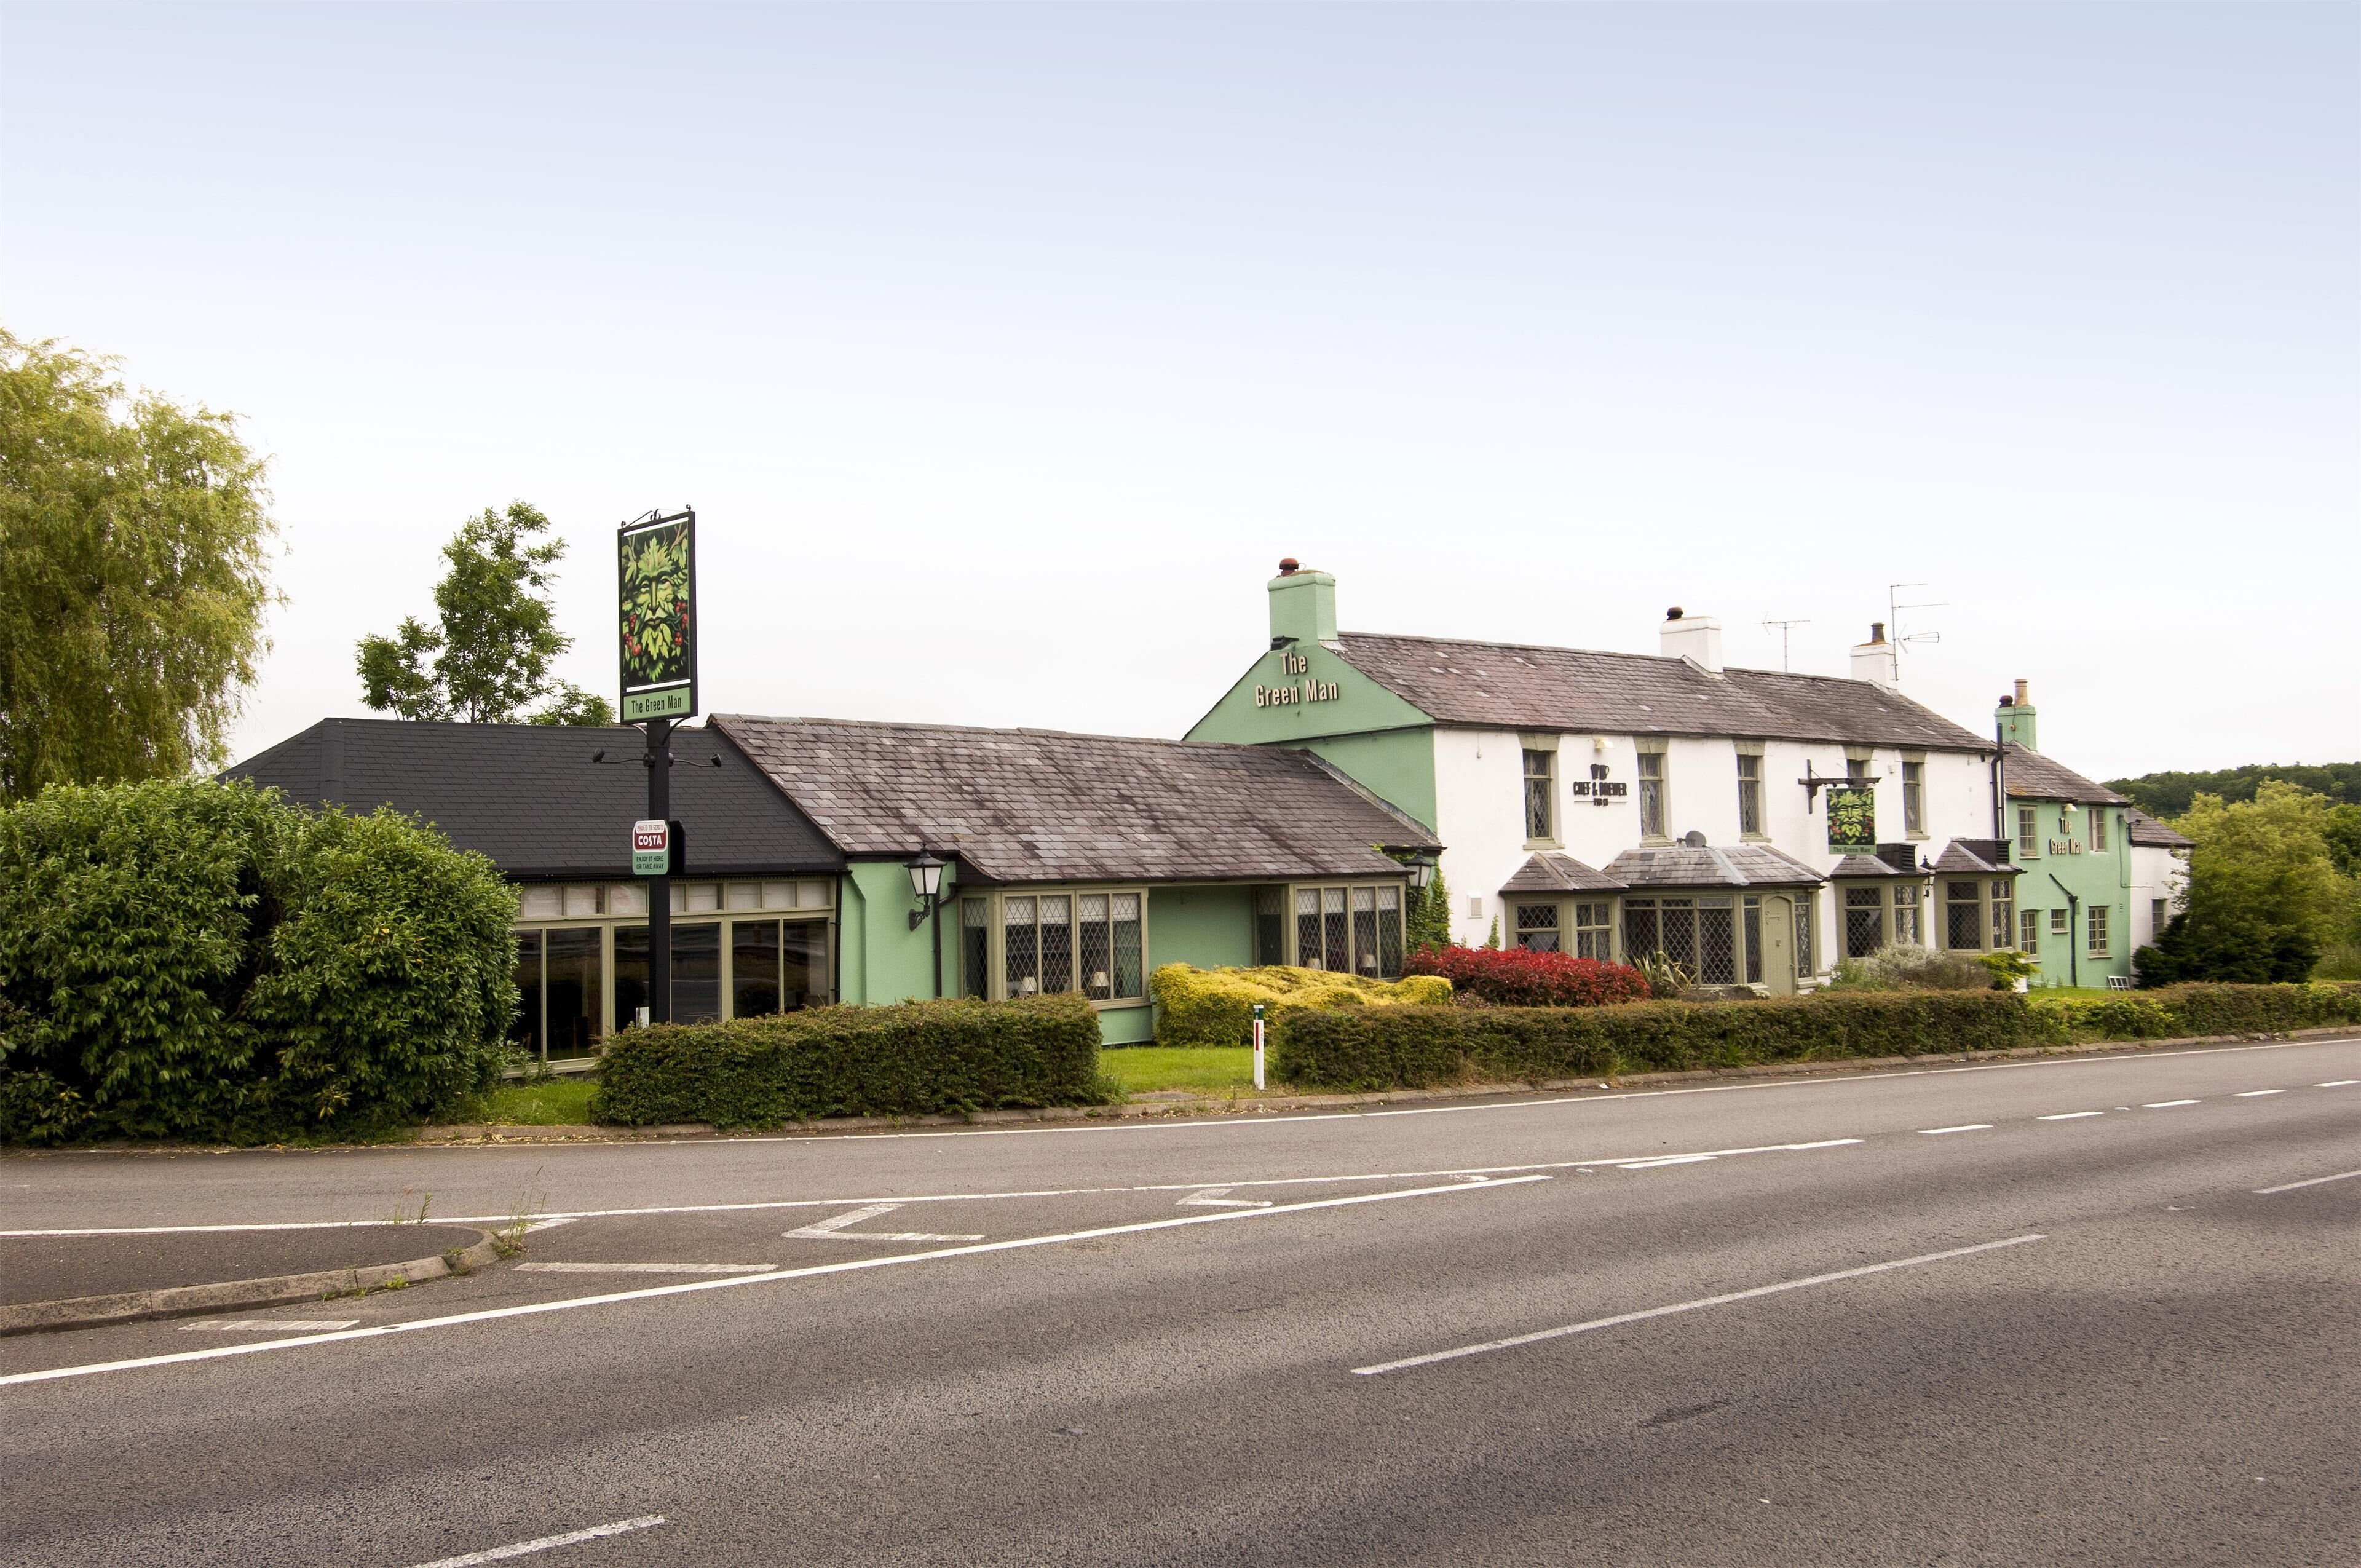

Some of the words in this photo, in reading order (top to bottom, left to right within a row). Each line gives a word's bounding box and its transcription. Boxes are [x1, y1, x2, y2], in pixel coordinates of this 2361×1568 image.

[1279, 652, 1307, 675] The
[1256, 684, 1299, 707] Green
[1305, 679, 1338, 702] Man
[631, 700, 643, 714] The
[646, 698, 665, 712] Green
[668, 695, 682, 709] Man
[1592, 782, 1598, 796] &
[2059, 817, 2072, 833] The
[638, 835, 662, 846] COSTA
[2049, 838, 2068, 854] Green
[2070, 838, 2083, 854] Man
